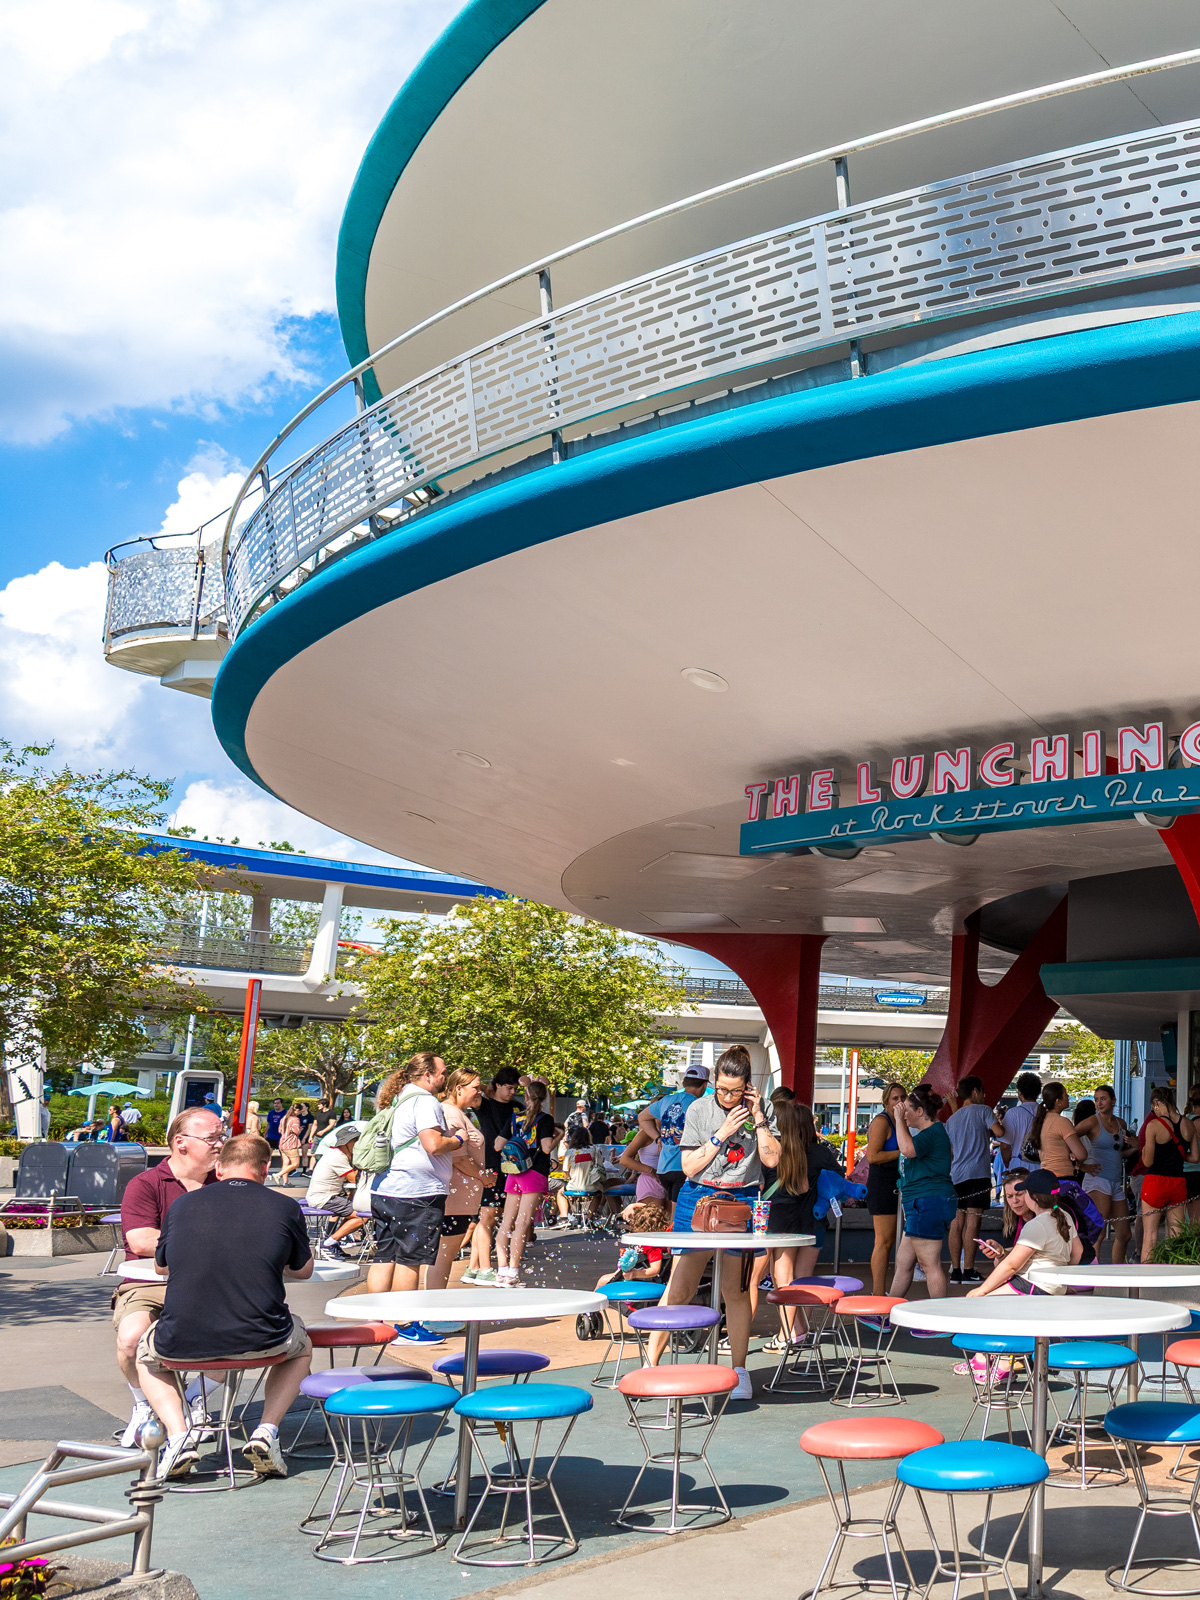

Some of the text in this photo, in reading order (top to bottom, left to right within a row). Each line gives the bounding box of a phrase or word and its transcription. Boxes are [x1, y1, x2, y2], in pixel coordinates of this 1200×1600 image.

[745, 768, 839, 822] THE
[830, 820, 857, 837] at
[871, 793, 1098, 832] Rockettower
